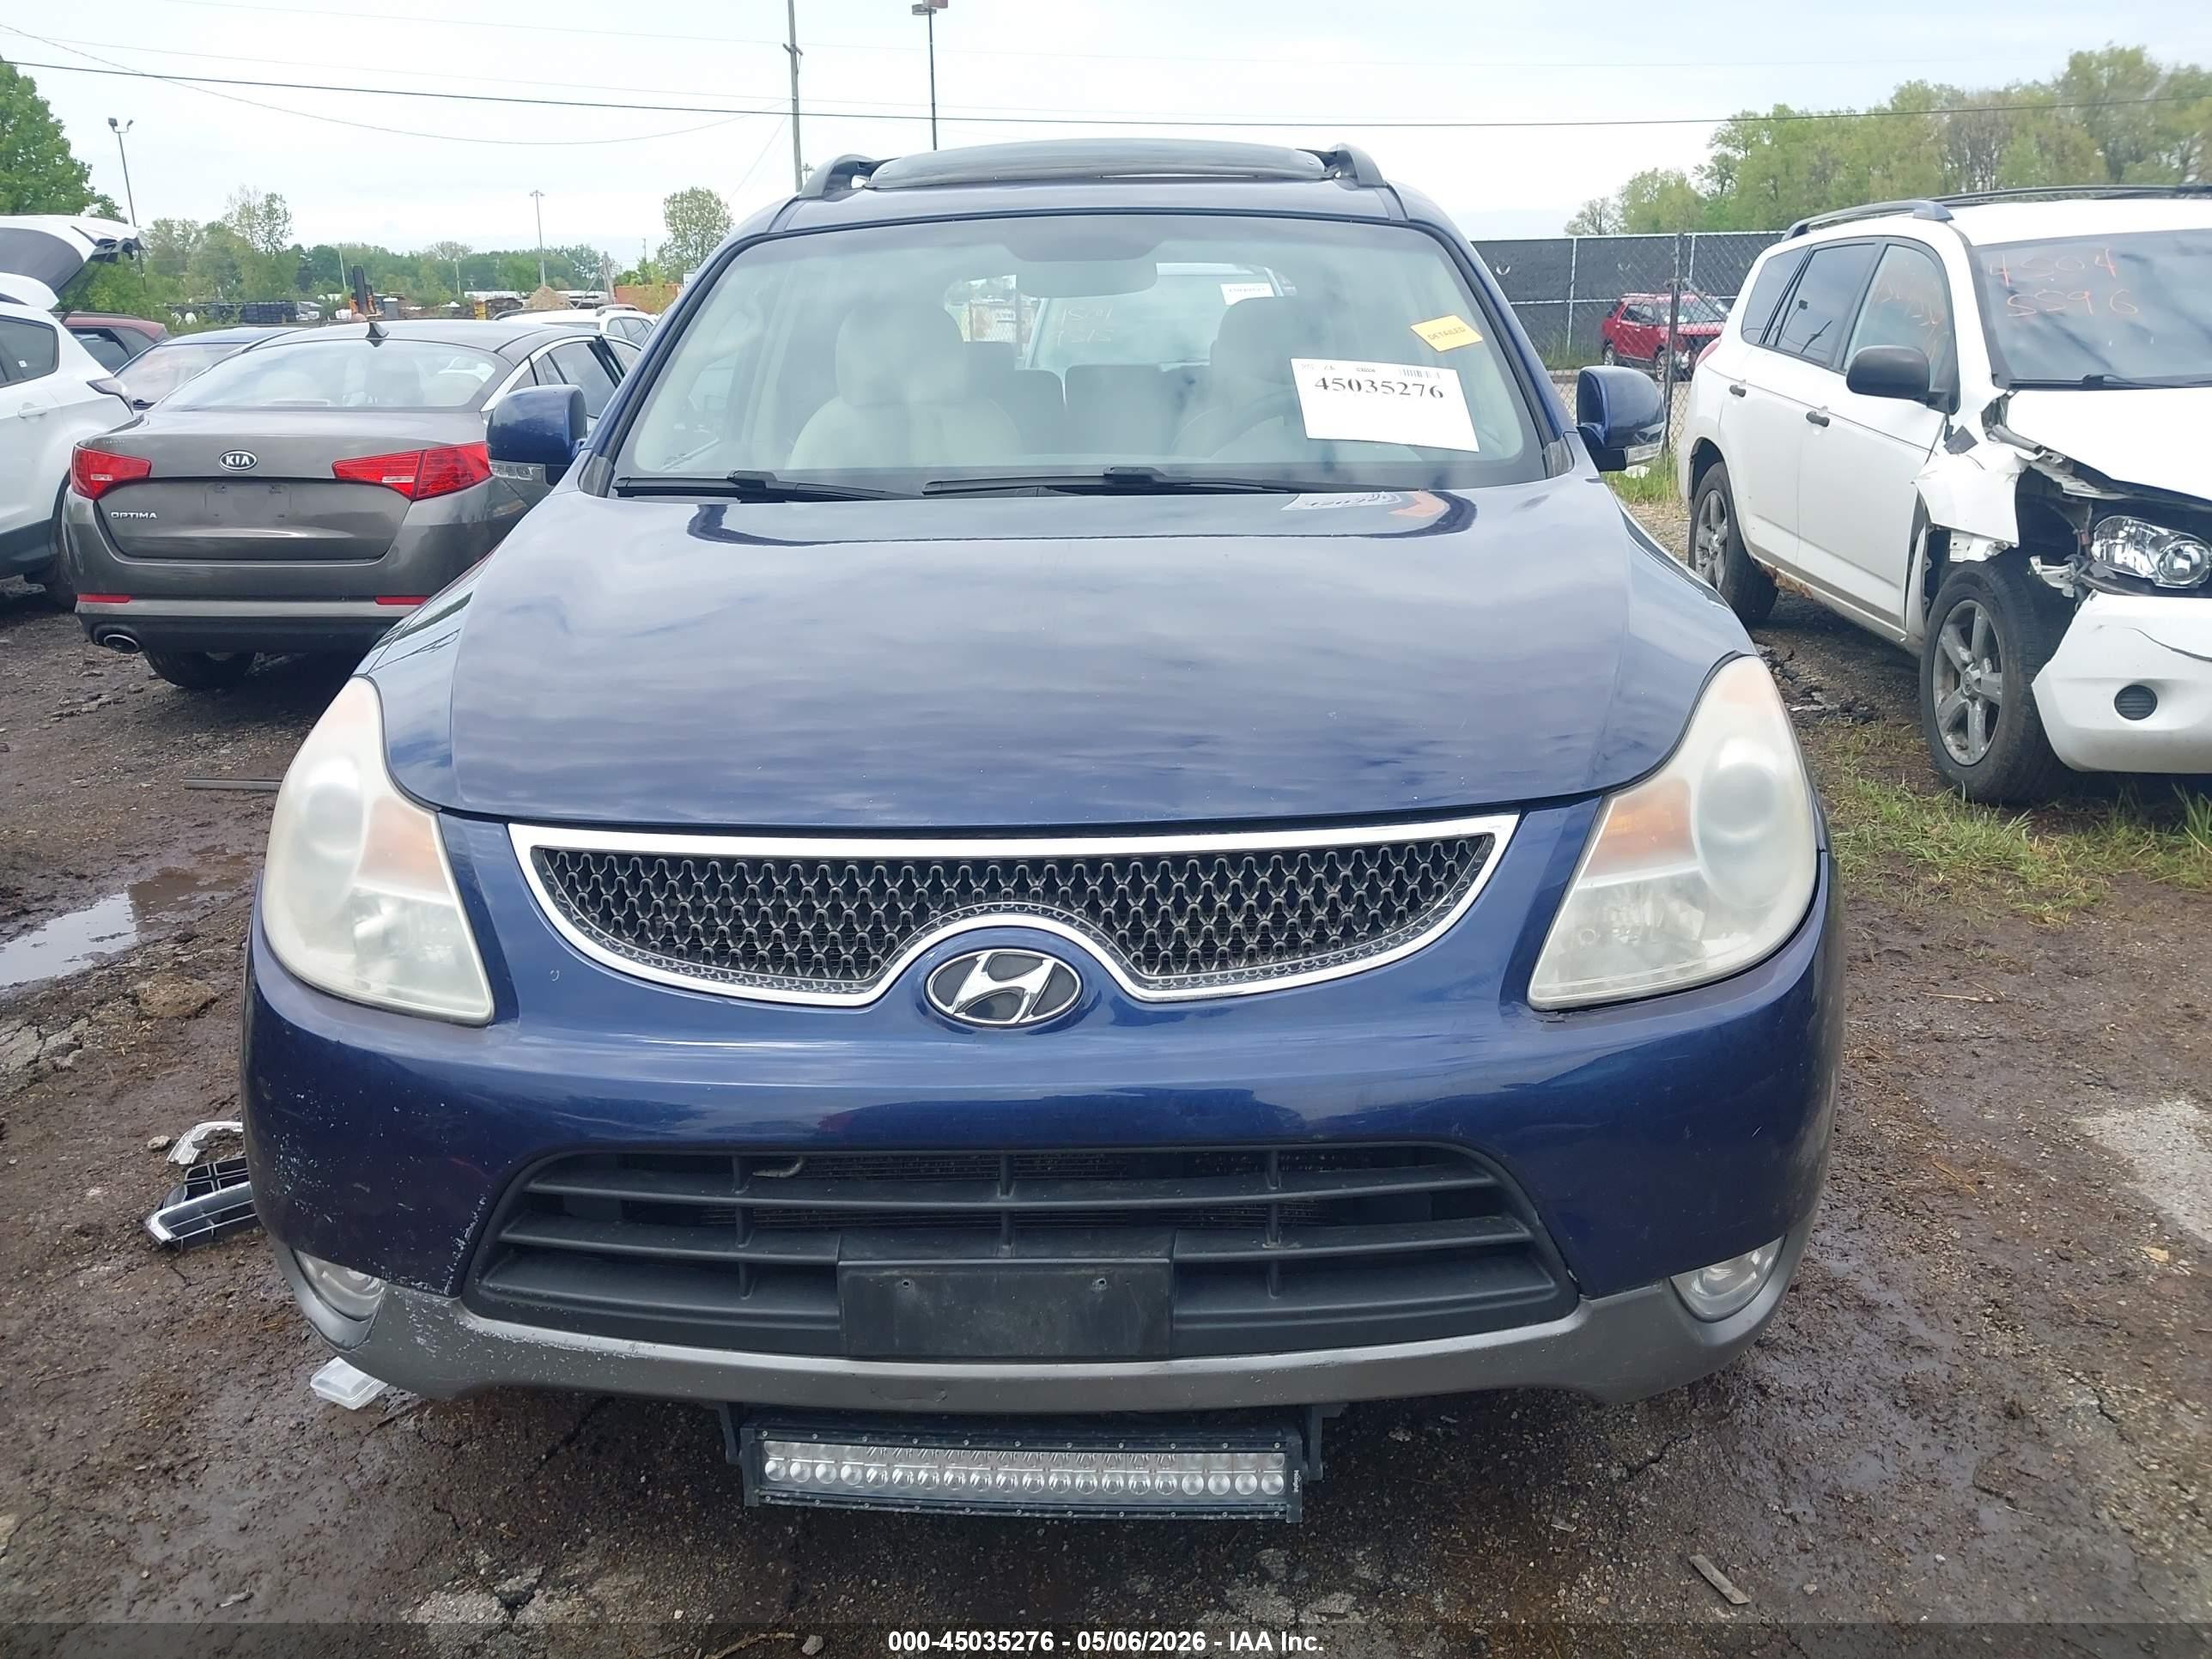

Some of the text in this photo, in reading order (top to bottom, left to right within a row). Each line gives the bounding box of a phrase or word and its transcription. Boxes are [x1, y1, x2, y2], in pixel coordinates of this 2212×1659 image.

[1314, 376, 1444, 399] 45035276
[225, 455, 251, 465] KIA
[110, 511, 158, 520] OPTIMA
